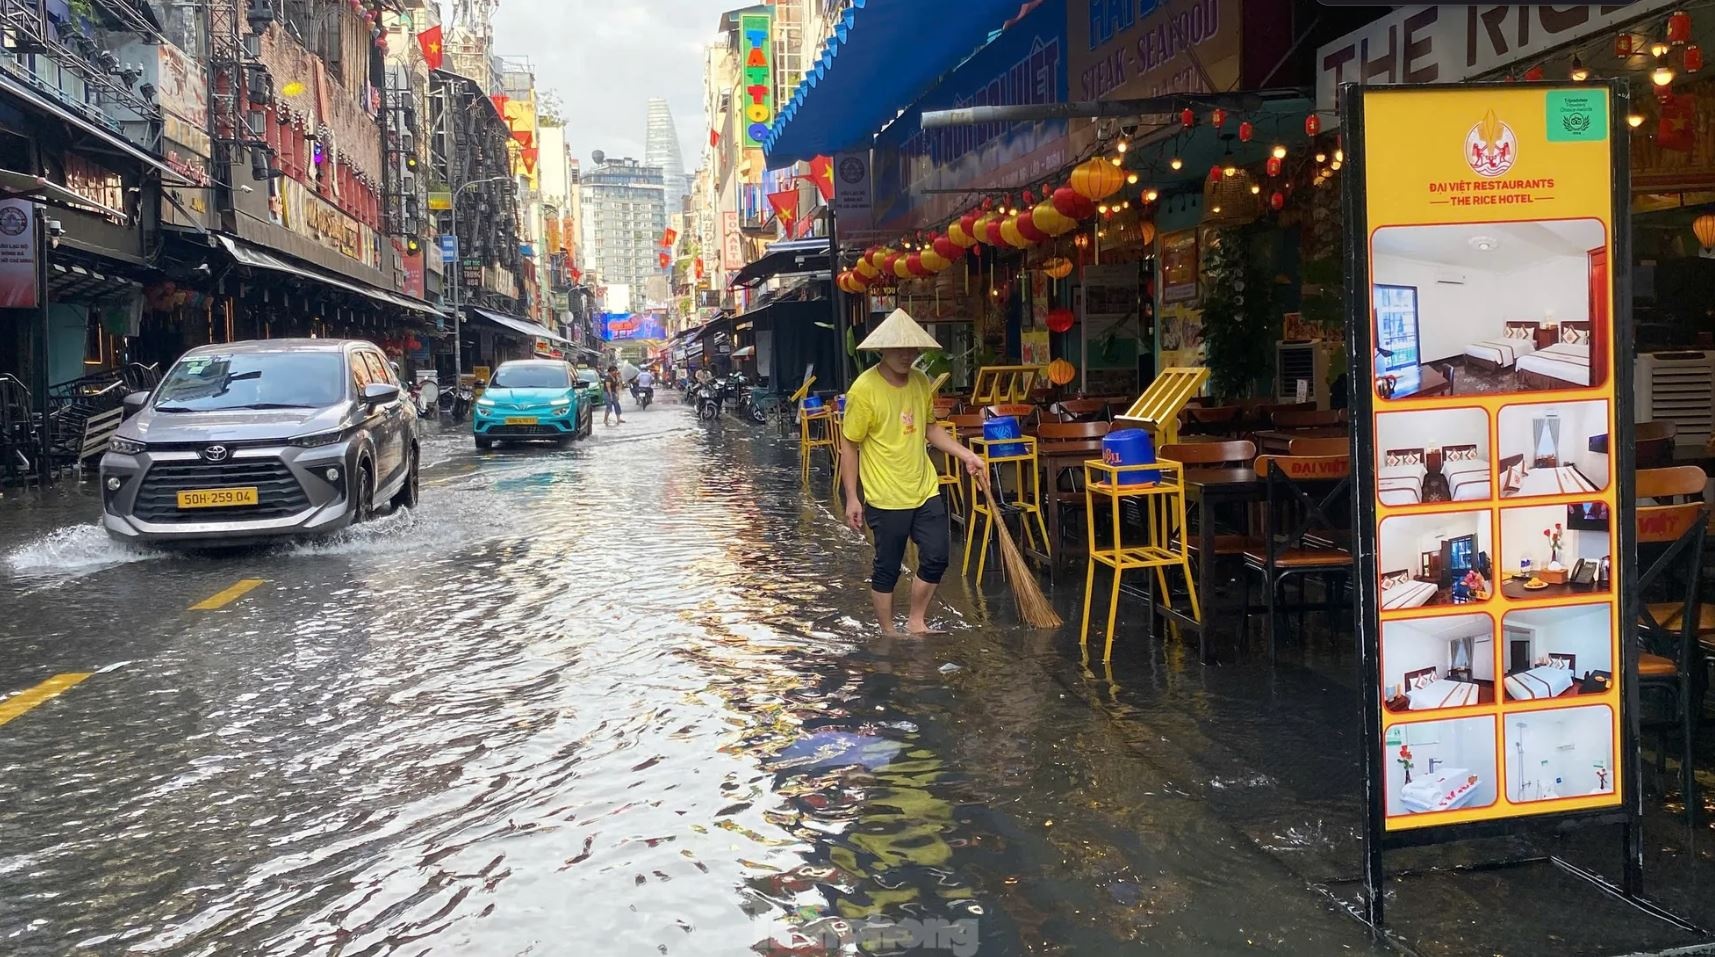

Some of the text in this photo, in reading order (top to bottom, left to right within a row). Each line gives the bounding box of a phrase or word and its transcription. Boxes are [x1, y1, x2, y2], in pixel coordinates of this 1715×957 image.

[745, 28, 770, 142] TATTOO
[1080, 46, 1128, 102] STEAK
[1324, 6, 1438, 116] THE
[1449, 180, 1472, 194] VIỆT
[1473, 178, 1555, 191] RESTAURANTS
[1450, 194, 1534, 206] THE RICE HOTEL
